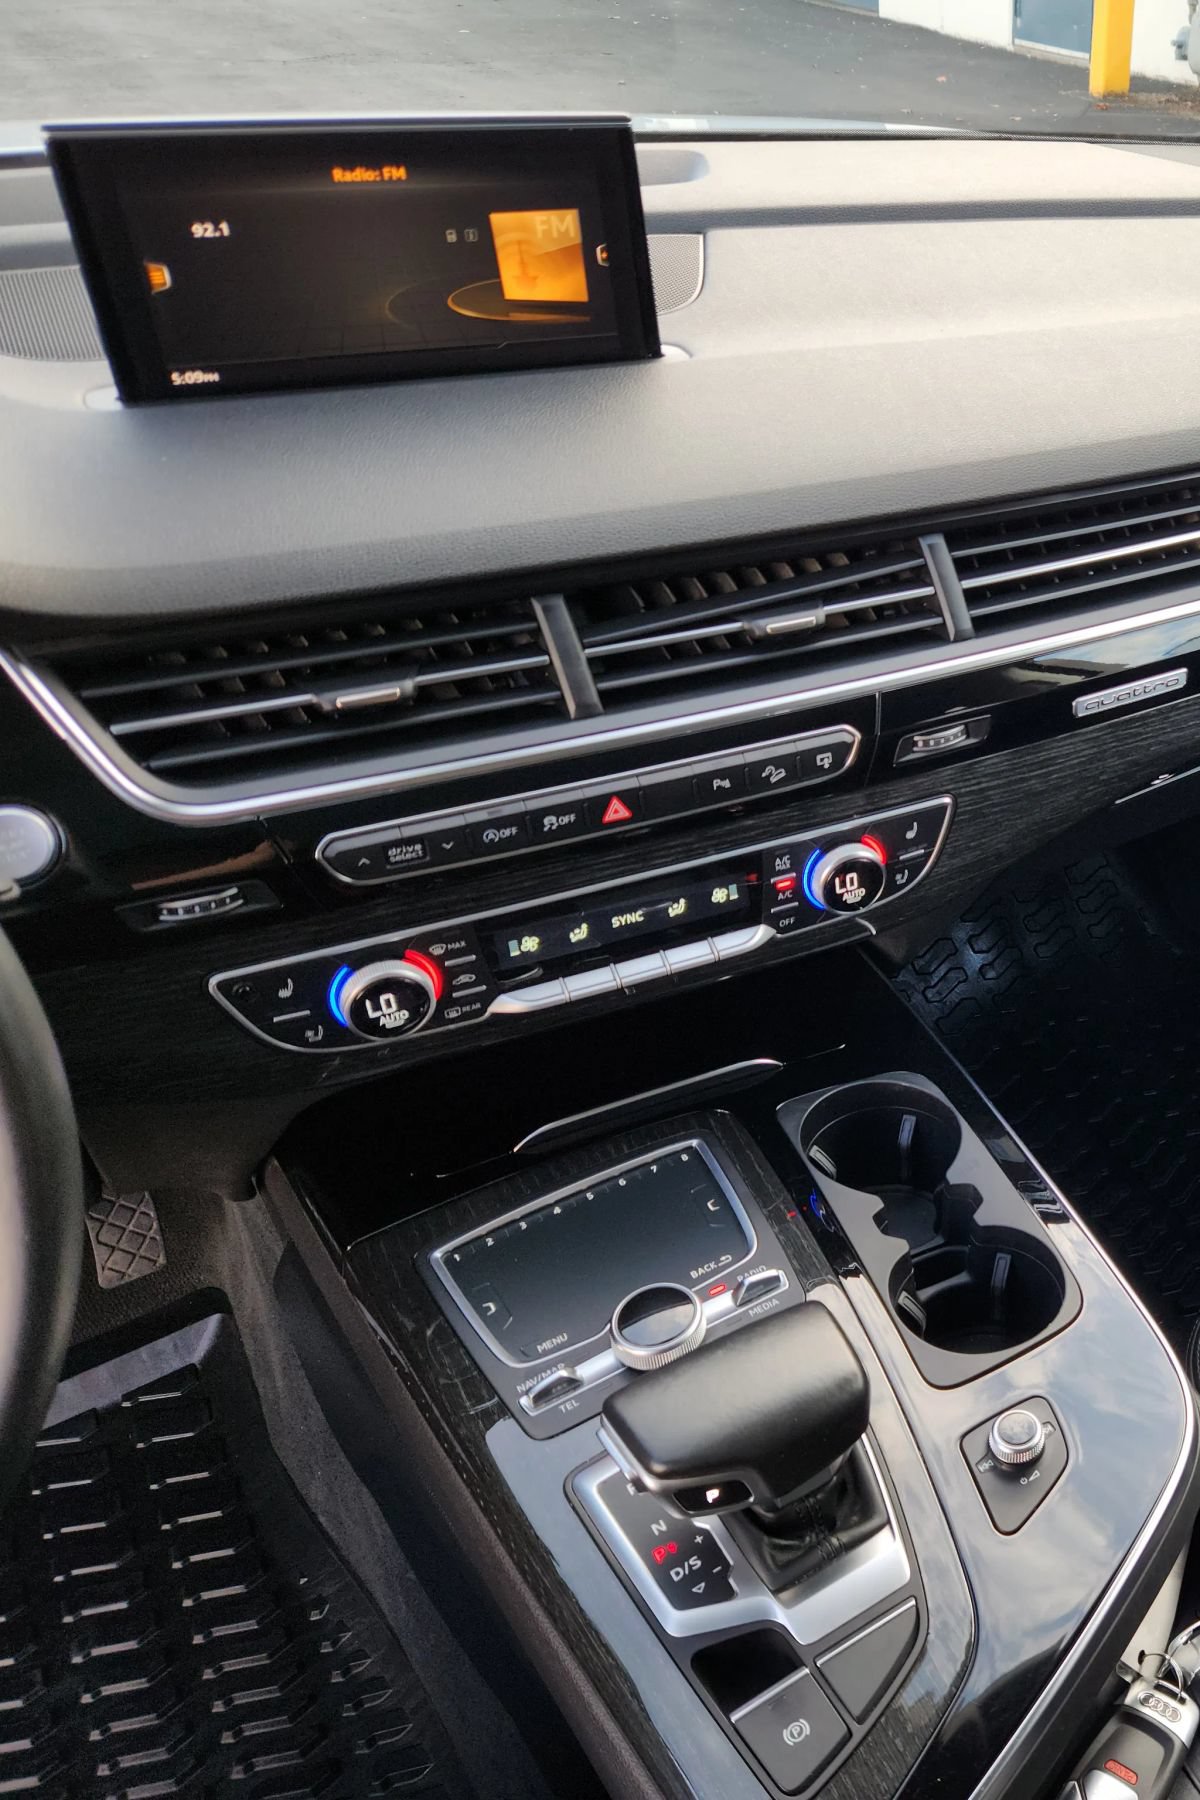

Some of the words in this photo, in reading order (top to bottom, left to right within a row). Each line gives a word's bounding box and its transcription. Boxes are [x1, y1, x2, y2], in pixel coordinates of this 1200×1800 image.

[332, 166, 381, 183] Radio:
[382, 164, 407, 181] FM
[191, 220, 230, 239] 92.1
[535, 214, 575, 239] FM
[1084, 678, 1180, 711] quattro
[558, 813, 577, 826] OFF
[499, 826, 519, 840] OFF
[388, 843, 423, 858] drive
[774, 855, 791, 866] A/C
[777, 890, 793, 901] A/C
[842, 887, 866, 902] AUTO
[611, 910, 645, 929] SYNC
[779, 916, 795, 927] OFF
[447, 941, 467, 952] MAX
[461, 1002, 481, 1014] REAR
[380, 1009, 410, 1027] AUTO
[690, 1260, 718, 1280] BACK
[747, 1298, 780, 1318] MEDIA
[536, 1332, 568, 1353] MENU
[558, 1400, 580, 1415] TEL
[705, 1488, 720, 1504] P
[650, 1519, 667, 1536] N
[651, 1545, 667, 1565] P
[669, 1555, 702, 1582] D/S
